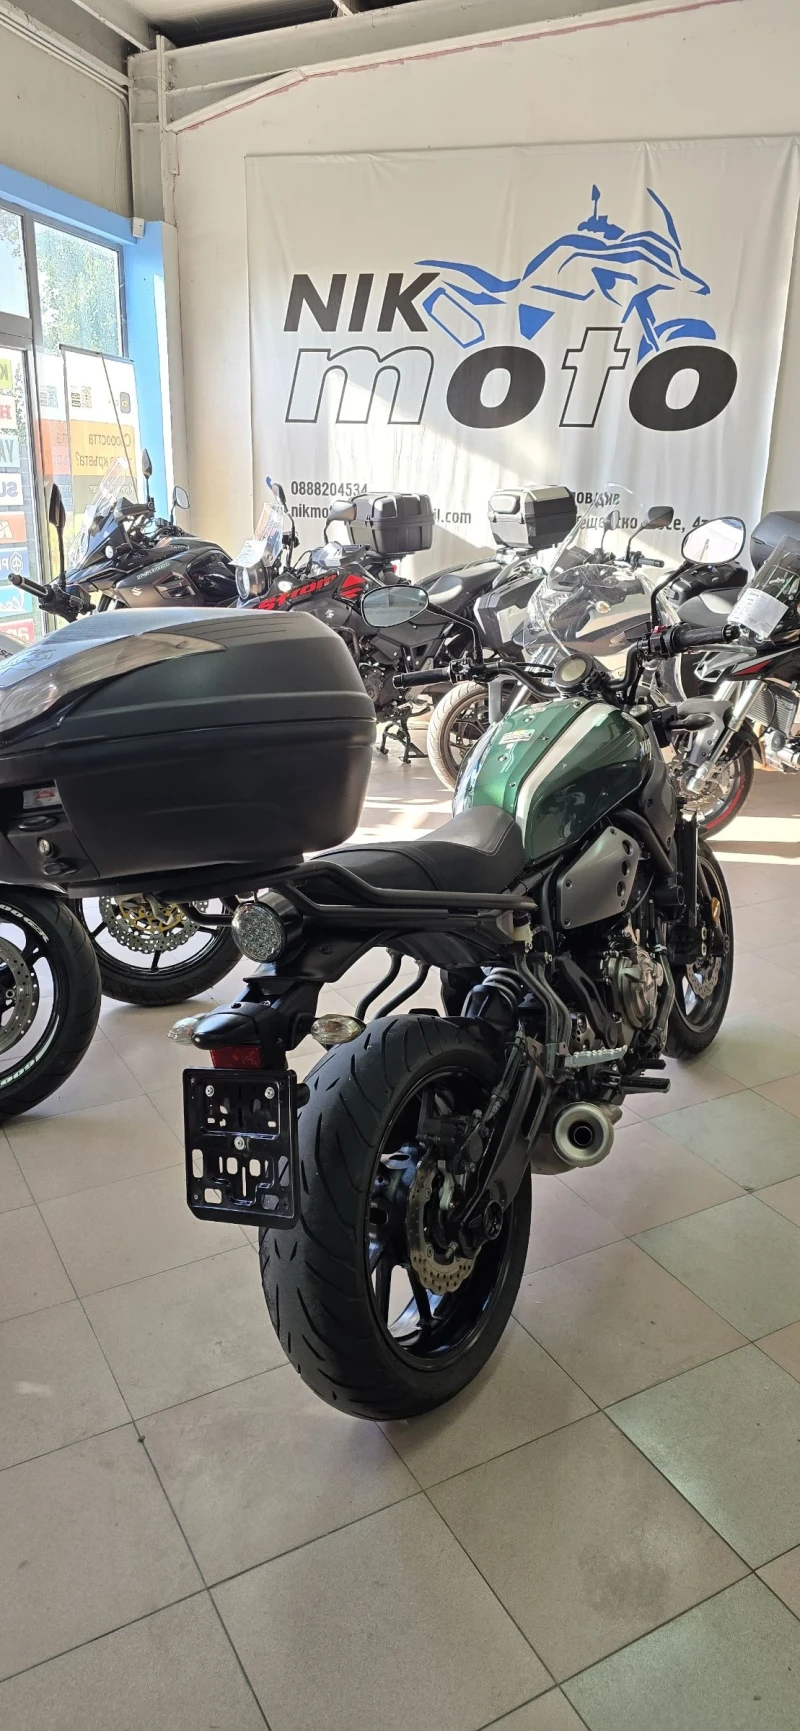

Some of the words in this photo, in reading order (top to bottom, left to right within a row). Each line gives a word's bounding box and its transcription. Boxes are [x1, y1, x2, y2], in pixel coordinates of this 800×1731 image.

[283, 272, 440, 333] NIK
[285, 327, 738, 432] moto
[291, 480, 368, 497] 0888204534
